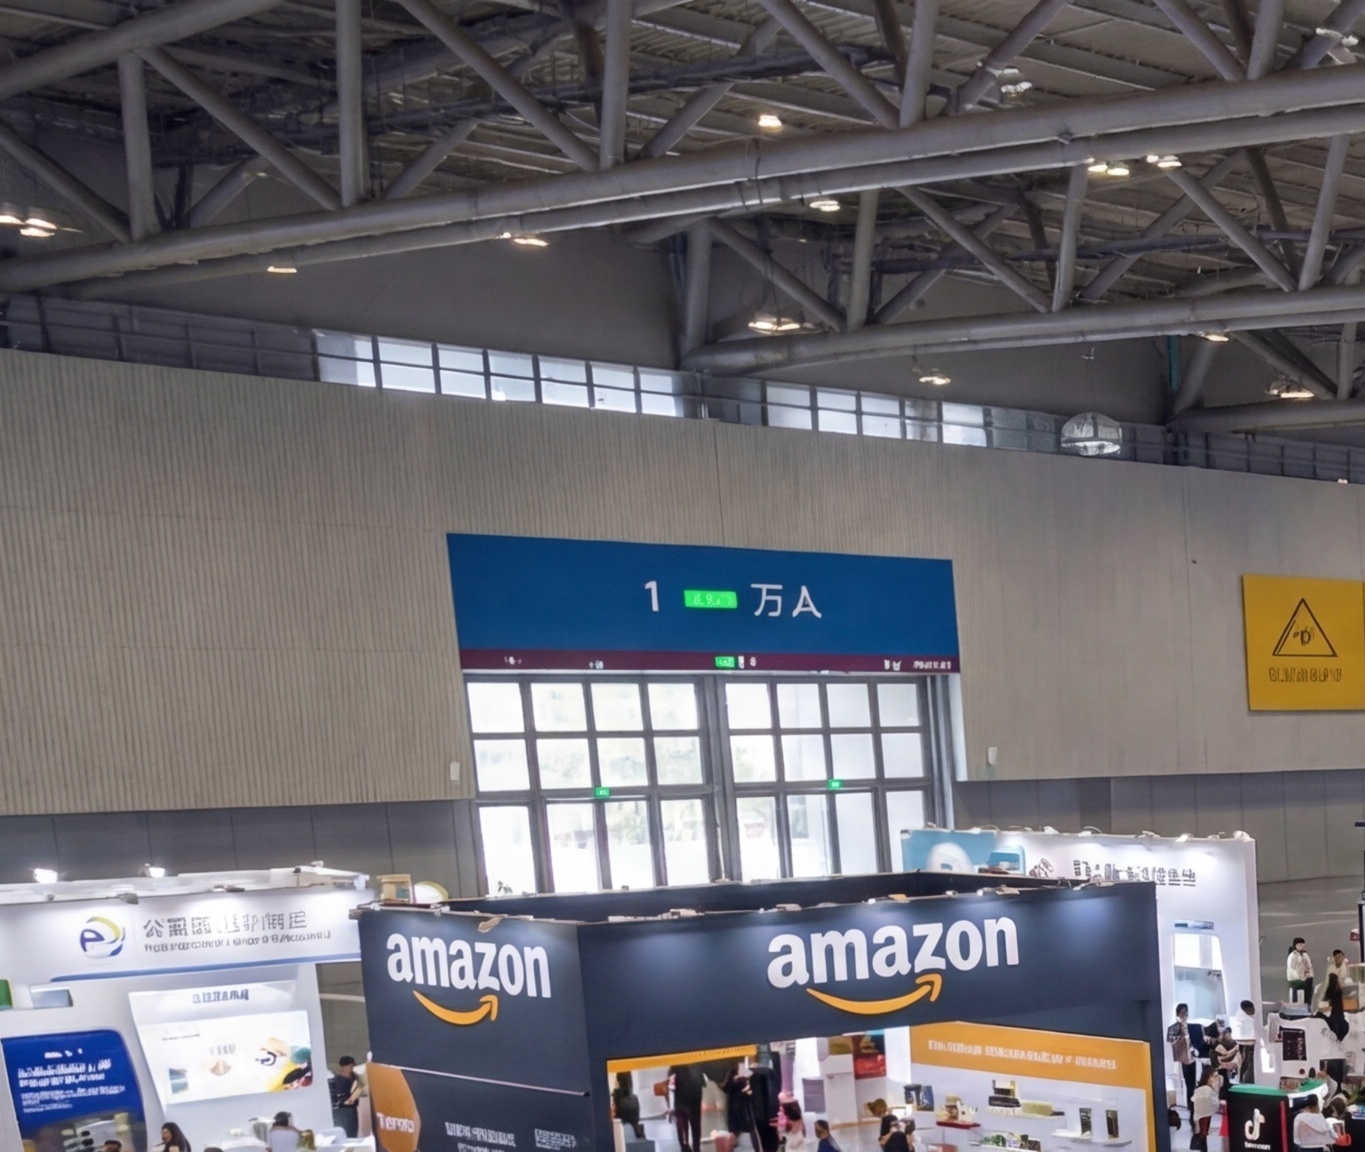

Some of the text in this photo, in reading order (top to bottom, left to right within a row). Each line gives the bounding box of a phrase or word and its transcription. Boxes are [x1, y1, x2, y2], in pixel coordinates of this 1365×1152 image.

[644, 580, 660, 612] 1
[387, 932, 552, 998] amazon
[767, 916, 1019, 988] amazon
